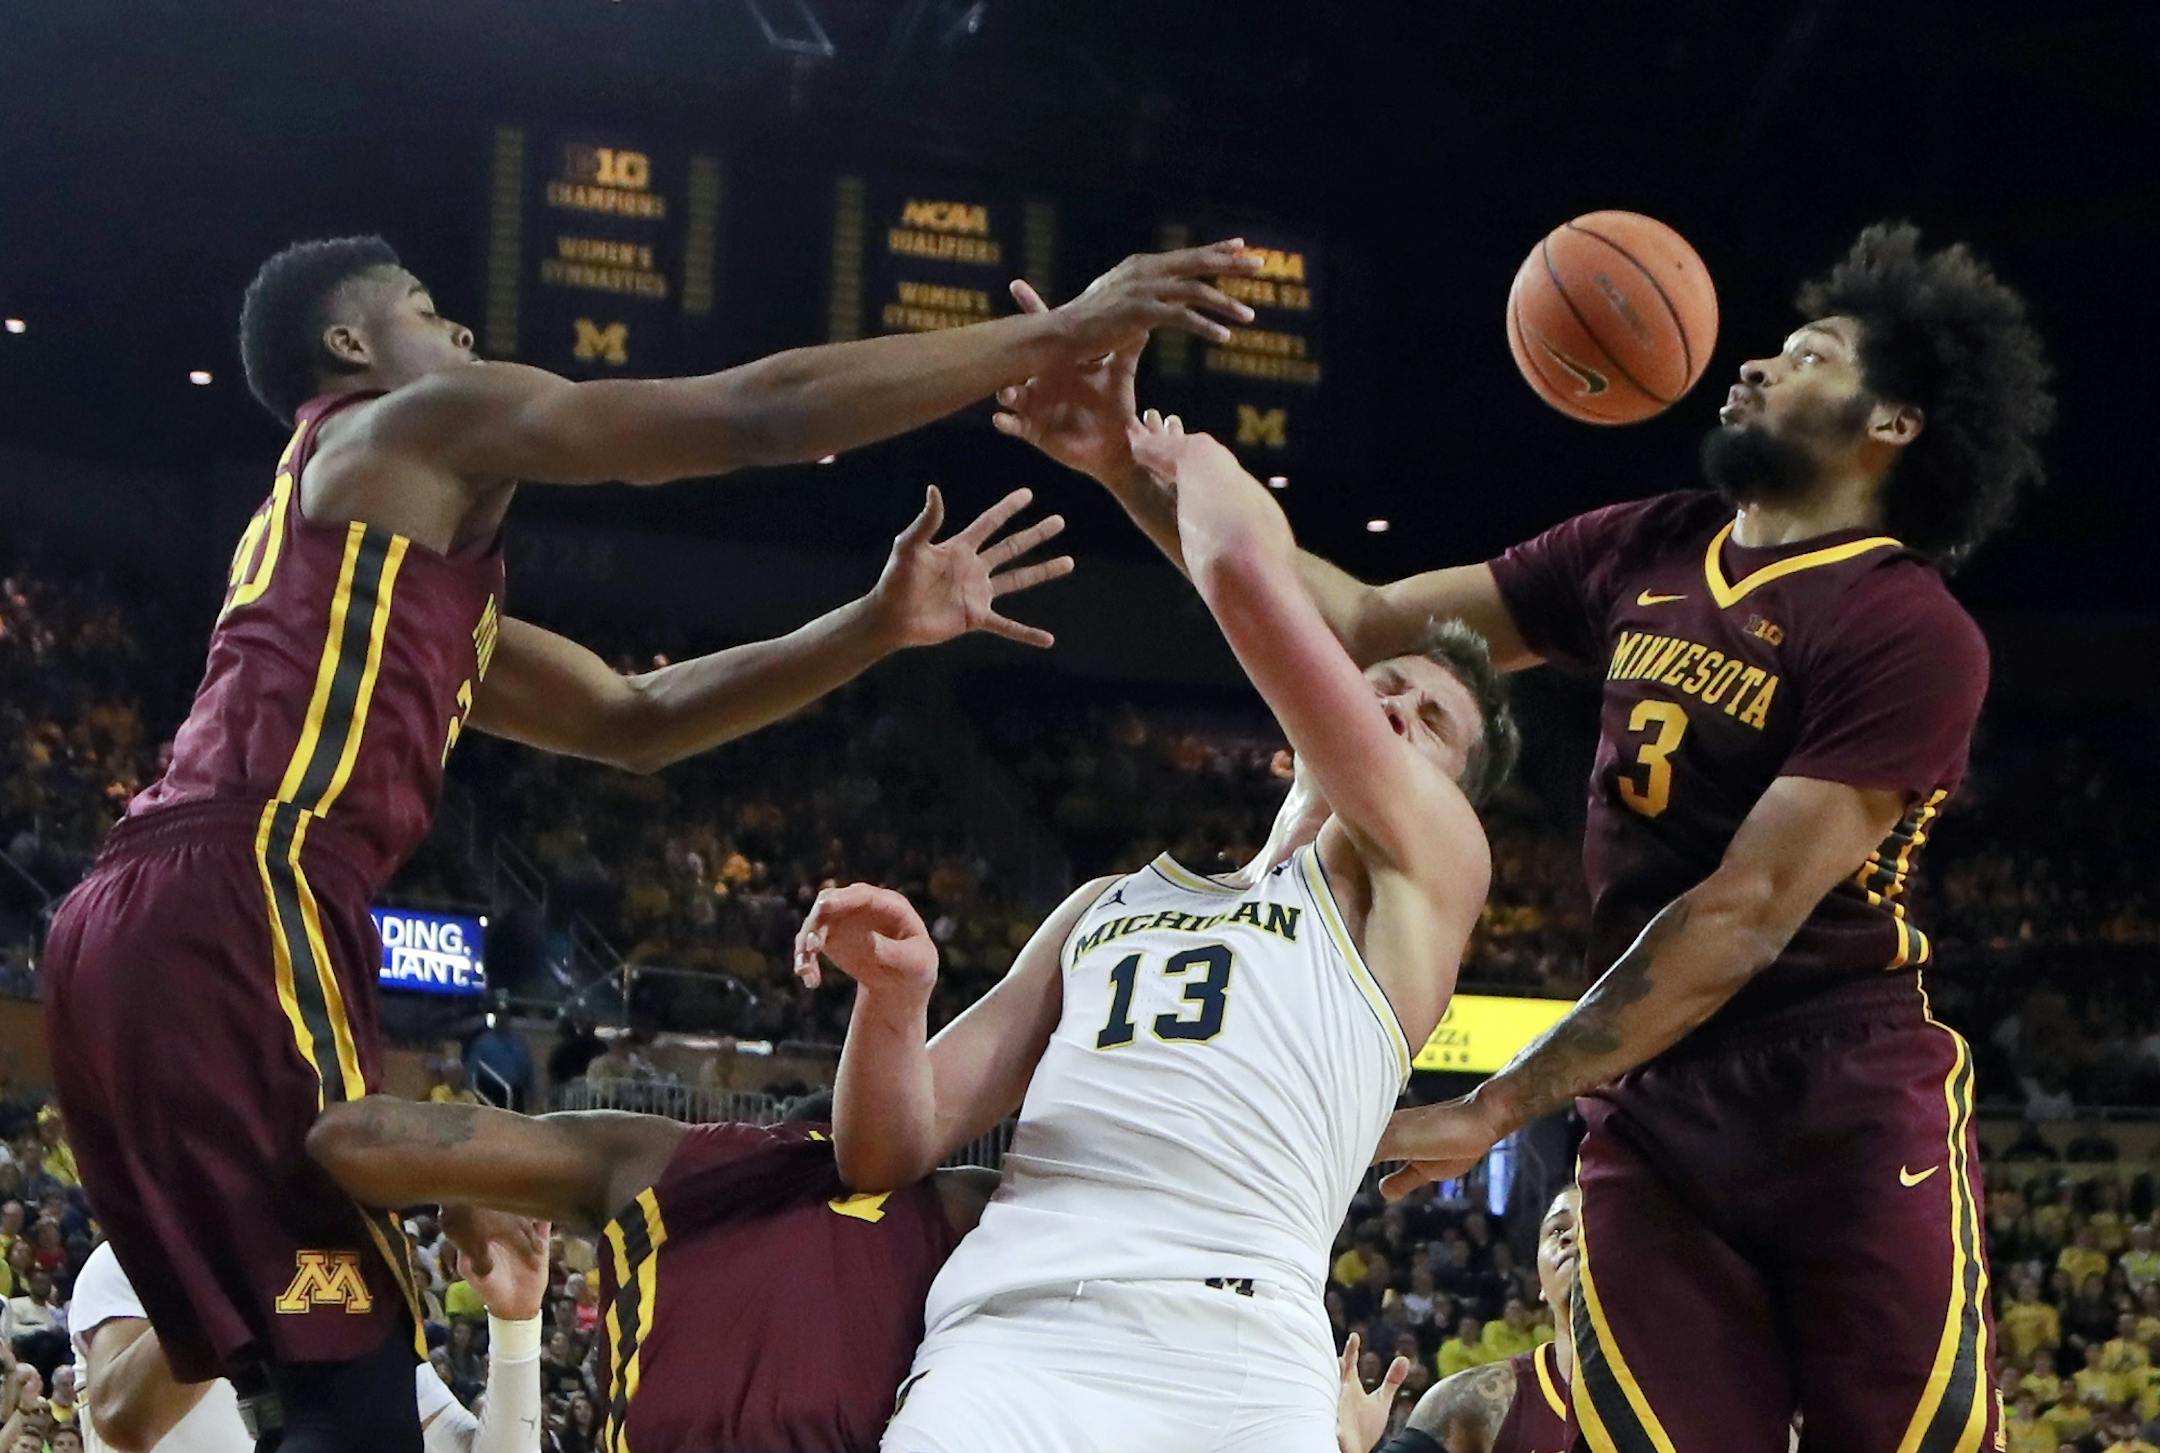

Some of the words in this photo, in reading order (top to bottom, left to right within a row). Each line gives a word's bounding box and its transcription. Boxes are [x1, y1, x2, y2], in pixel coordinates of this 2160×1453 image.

[573, 317, 630, 366] M
[1236, 403, 1287, 448] M
[1606, 631, 1779, 731] MINNESOTA
[1618, 699, 1689, 818] 3
[370, 913, 472, 957] DING.
[1095, 943, 1234, 1052] 13
[275, 1250, 373, 1314] M
